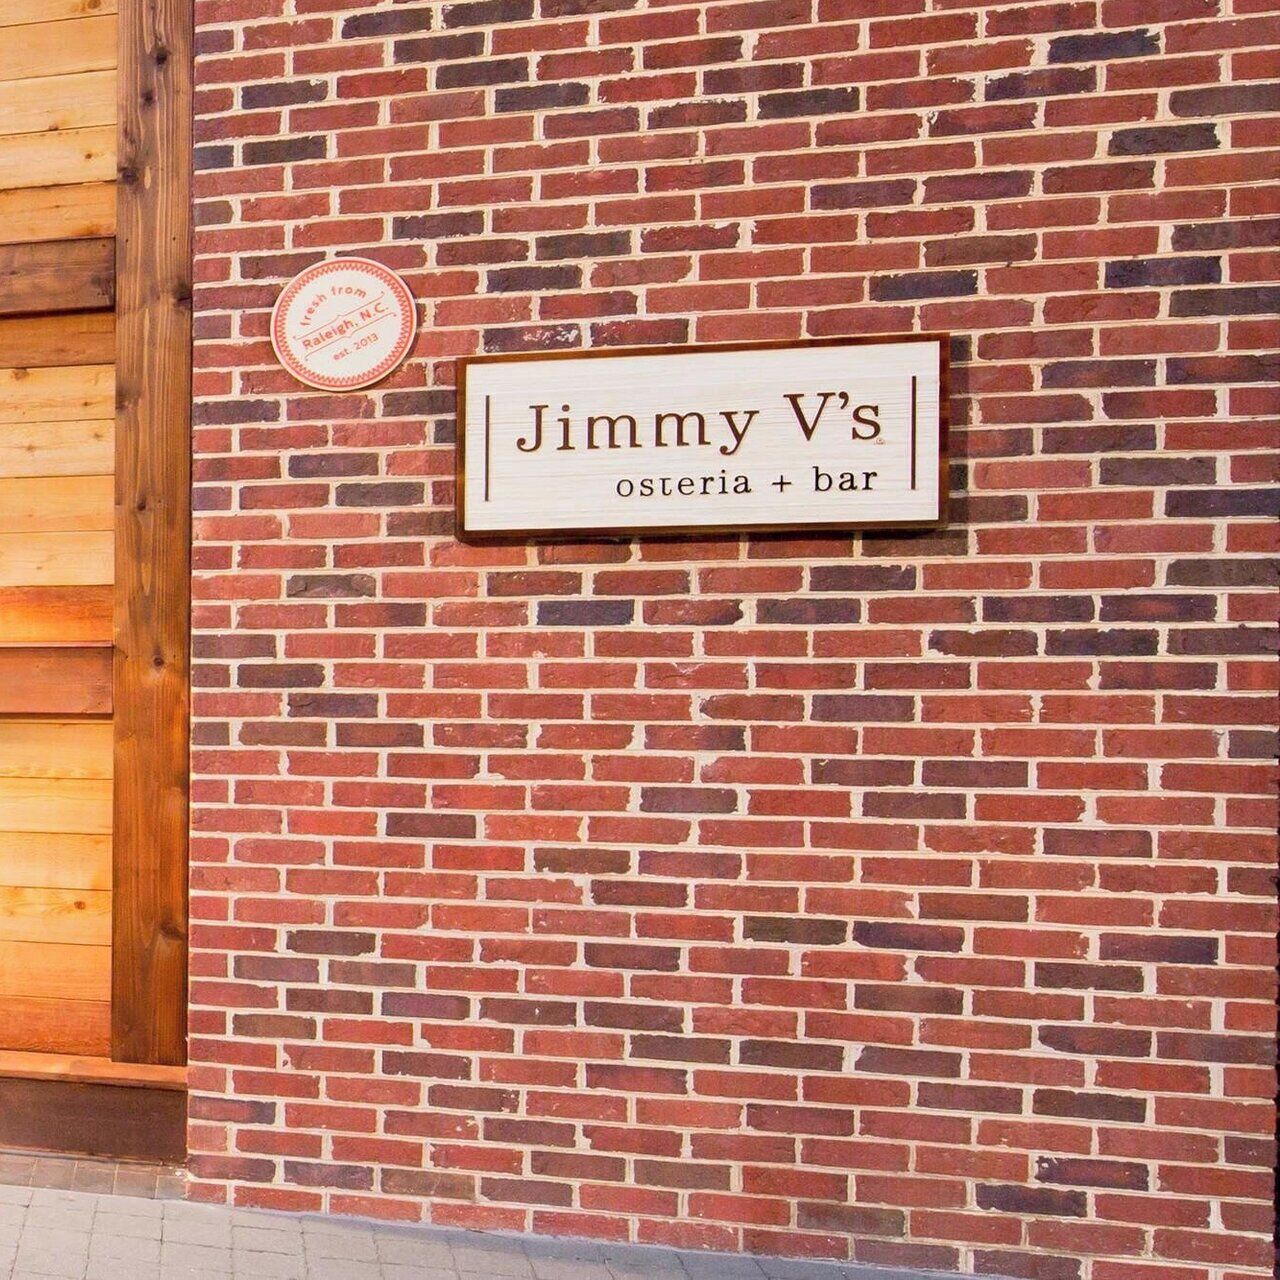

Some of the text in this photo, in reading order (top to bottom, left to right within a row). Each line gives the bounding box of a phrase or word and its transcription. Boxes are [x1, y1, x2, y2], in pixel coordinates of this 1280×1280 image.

[299, 285, 367, 327] fresh from
[302, 301, 389, 350] Raleigh, N.C.
[332, 332, 379, 361] est. 2013
[516, 390, 882, 456] Jimmy V’s
[616, 466, 879, 498] osteria + bar
